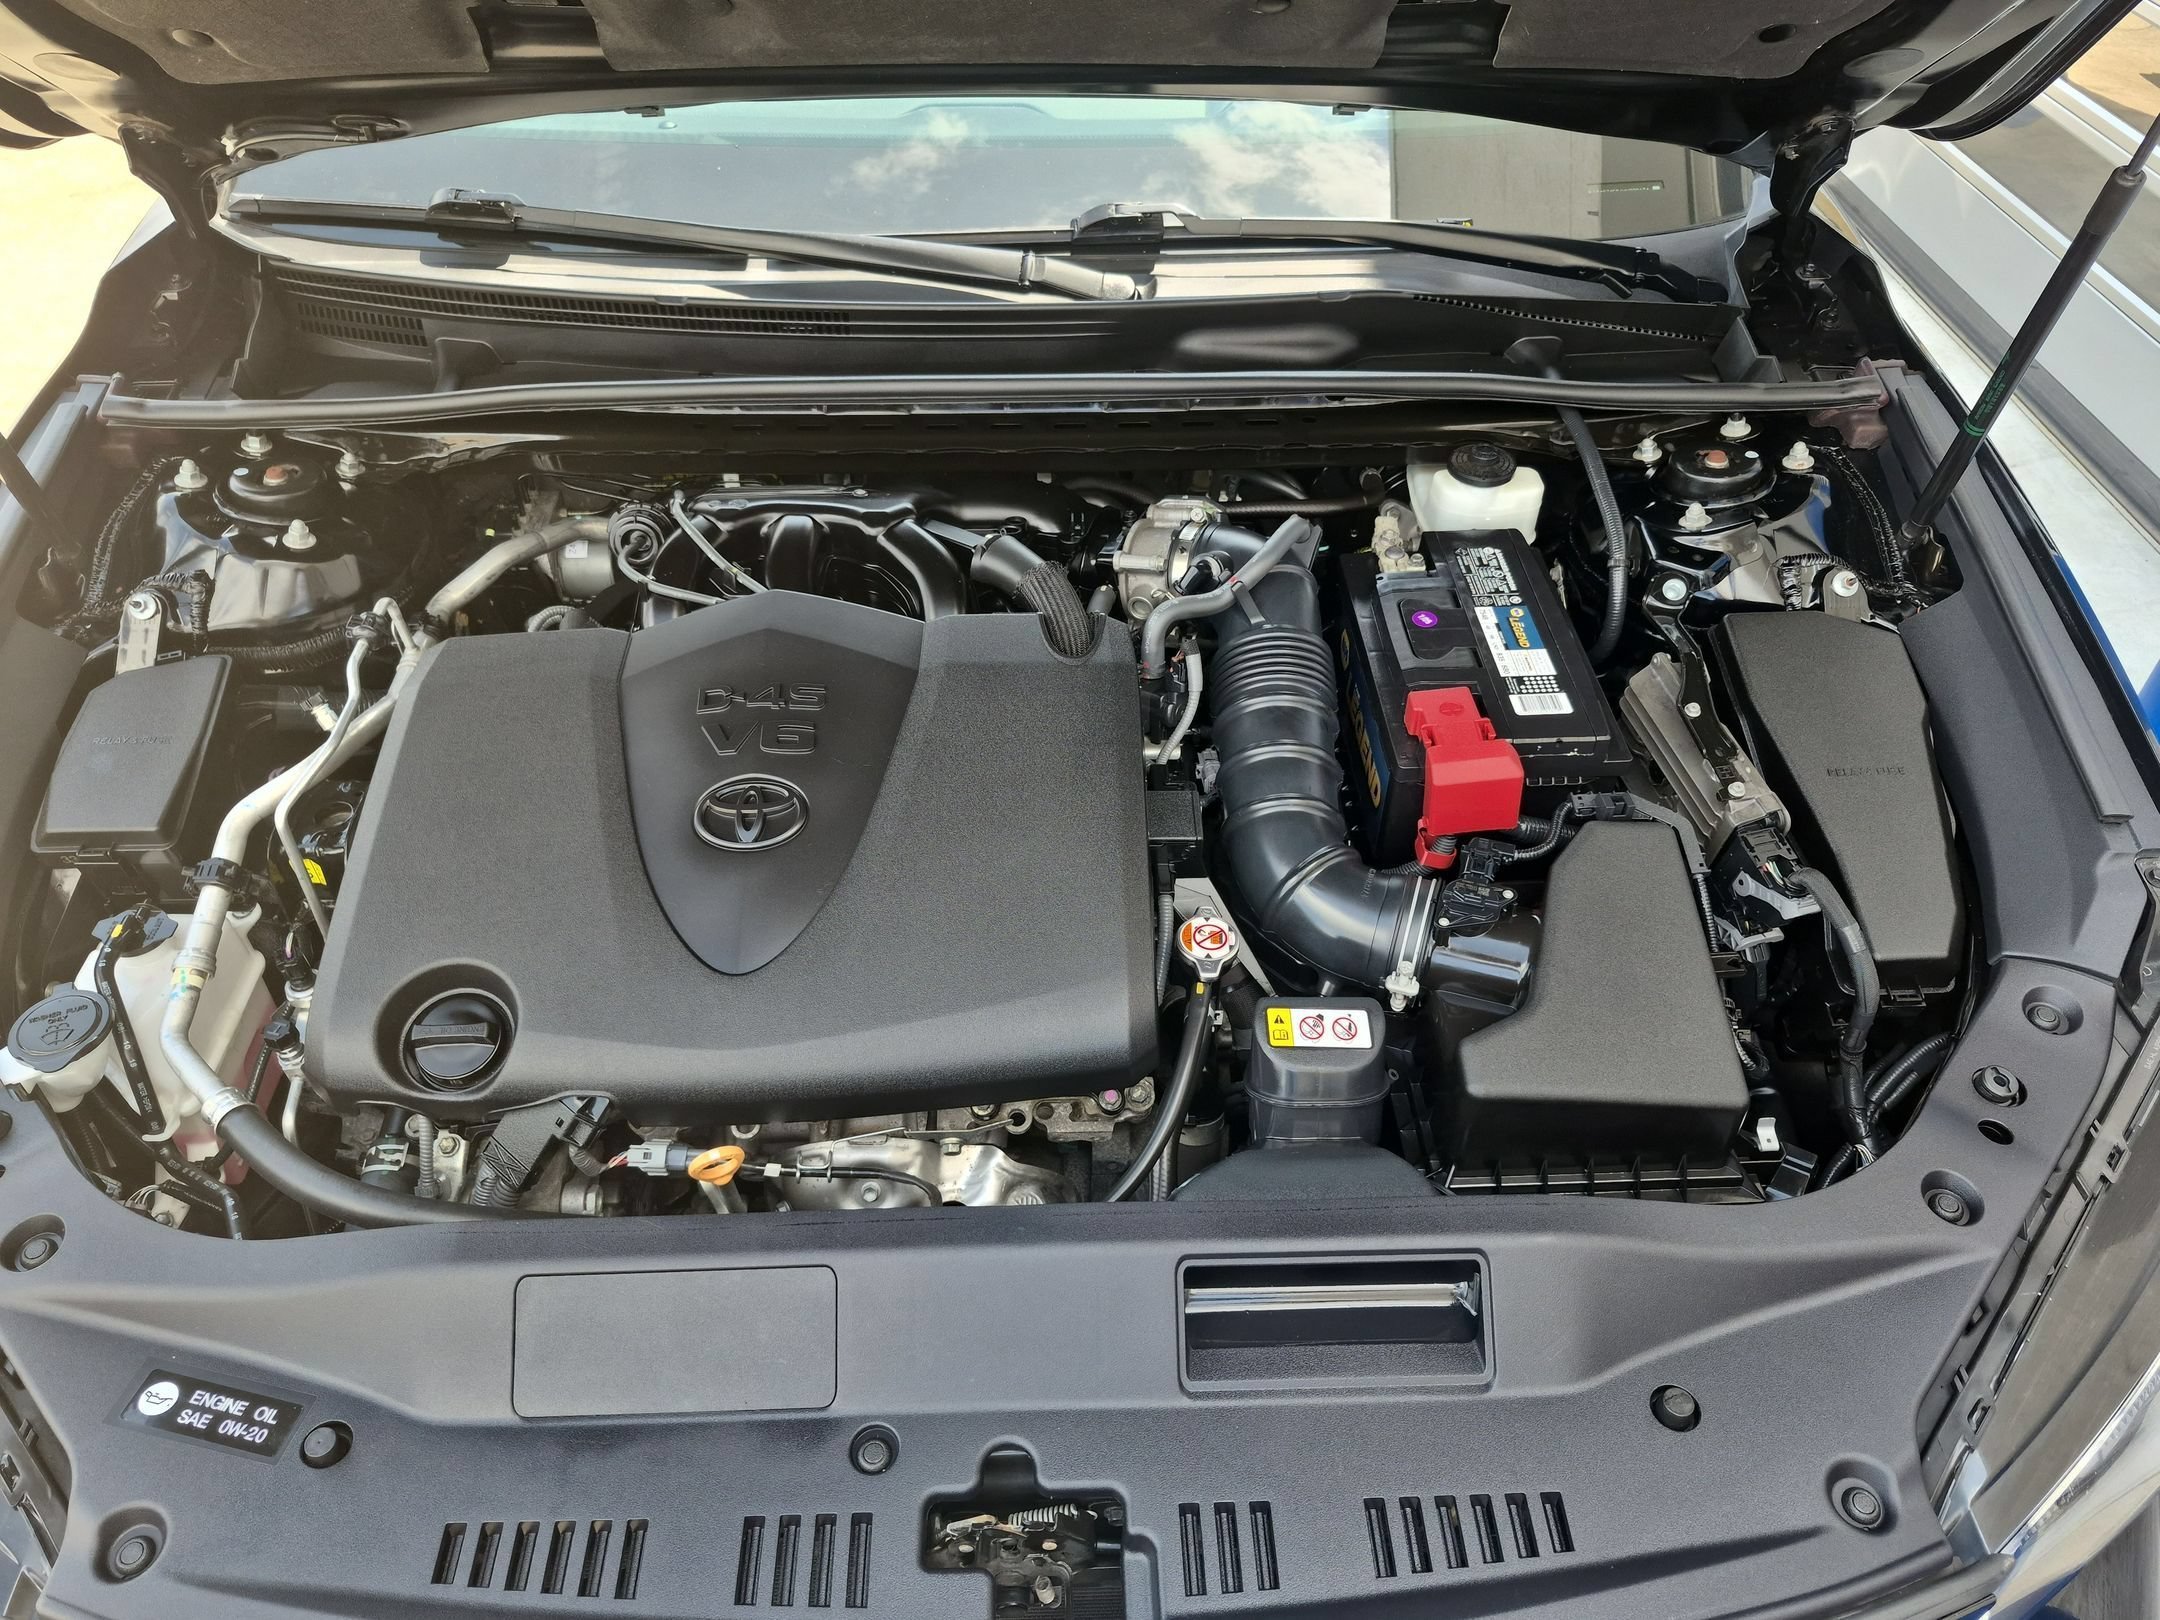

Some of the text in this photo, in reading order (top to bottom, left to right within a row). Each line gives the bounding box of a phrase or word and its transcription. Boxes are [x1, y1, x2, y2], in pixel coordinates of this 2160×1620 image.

[1508, 617, 1530, 648] LEGEND
[696, 683, 827, 715] D-4S
[701, 720, 816, 756] V6
[189, 1390, 279, 1425] ENGINE OIL
[177, 1409, 270, 1444] SAE 0W-20
